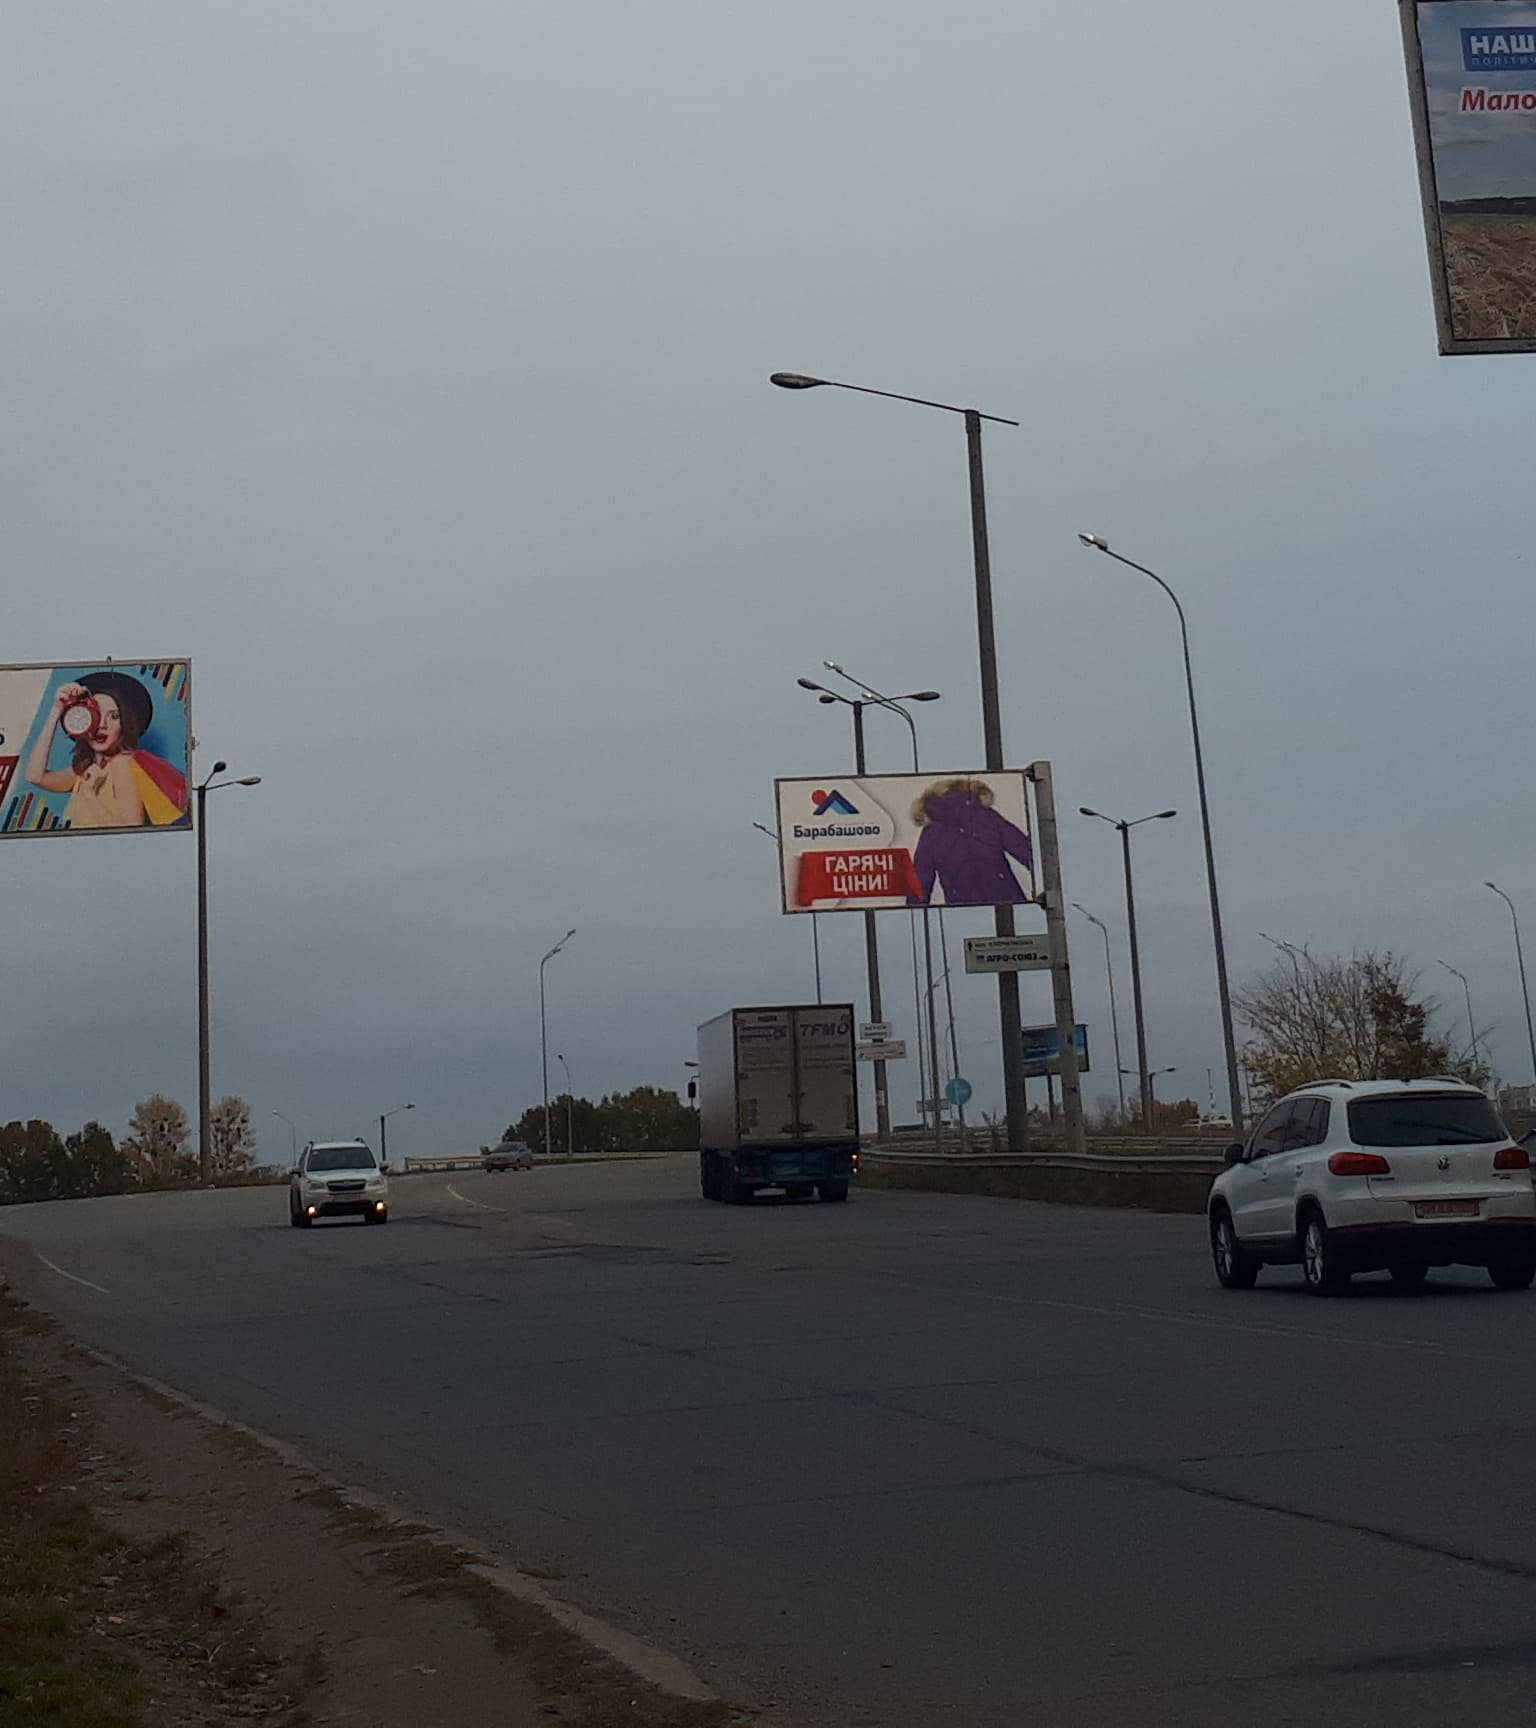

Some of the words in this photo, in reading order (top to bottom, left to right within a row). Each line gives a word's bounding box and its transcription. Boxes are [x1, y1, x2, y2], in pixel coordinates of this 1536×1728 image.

[1470, 34, 1535, 54] НАШ
[794, 824, 880, 839] Барабашово
[825, 855, 893, 873] ГАРЯЧІ
[833, 875, 888, 895] ЦІНИ!
